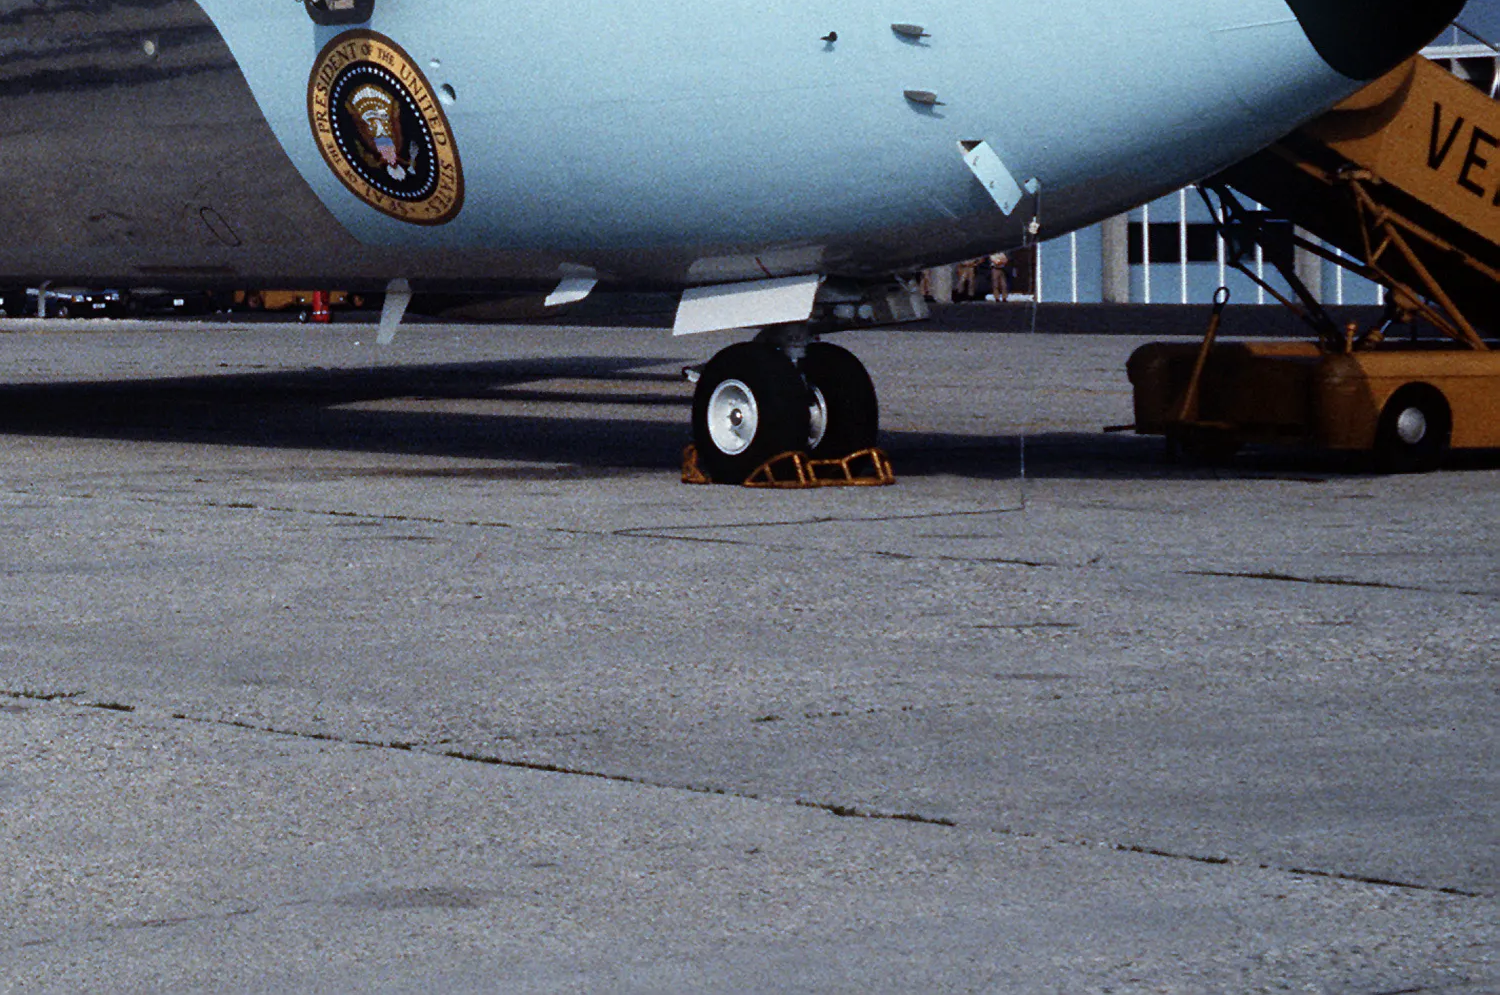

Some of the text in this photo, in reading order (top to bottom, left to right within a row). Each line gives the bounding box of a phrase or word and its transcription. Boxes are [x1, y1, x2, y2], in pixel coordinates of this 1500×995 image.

[315, 42, 357, 134] PRESIDENT
[360, 42, 372, 56] OF
[377, 48, 396, 67] THE
[399, 65, 448, 147] UNITED
[1427, 101, 1500, 206] VE
